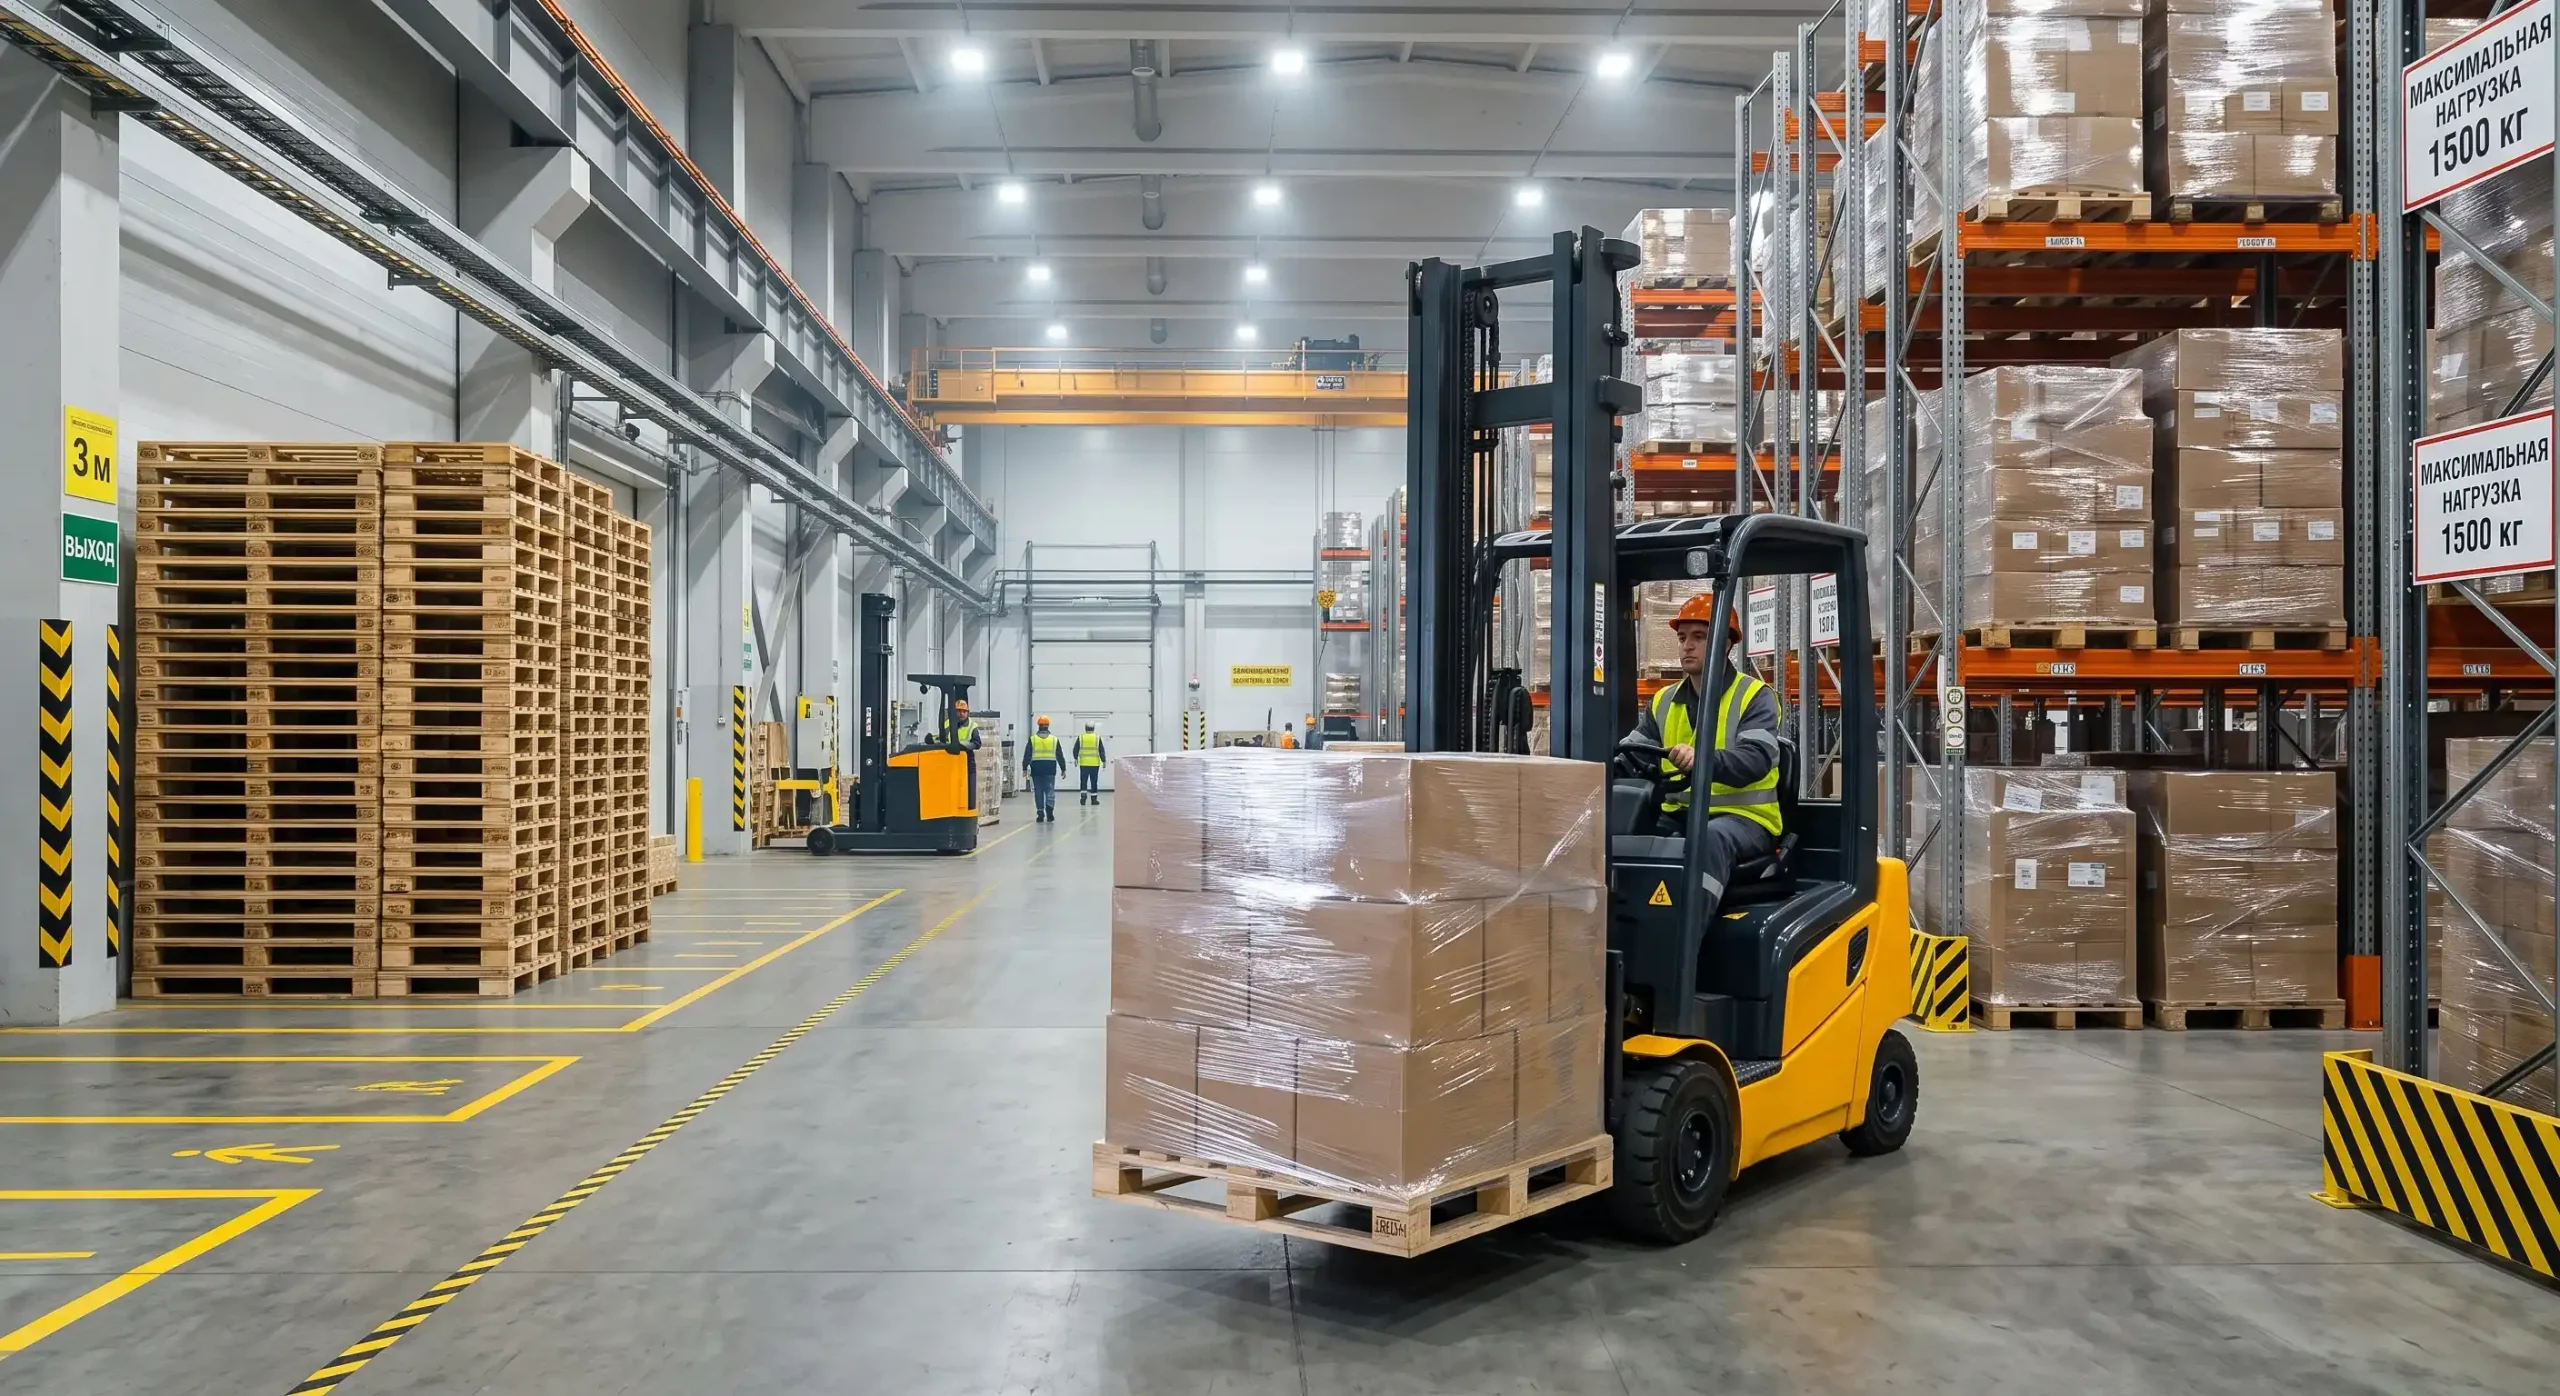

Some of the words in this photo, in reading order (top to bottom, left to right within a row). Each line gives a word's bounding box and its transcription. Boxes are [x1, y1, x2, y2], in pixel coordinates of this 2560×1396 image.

[2410, 13, 2552, 109] МАКСИМАЛЬНАЯ
[2436, 65, 2522, 128] НАГРУЗКА
[2428, 117, 2490, 177] 1500
[73, 437, 88, 477] 3
[2421, 437, 2549, 486] МАКСИМАЛЬНАЯ
[2443, 477, 2522, 514] НАГРУЗКА
[65, 534, 115, 568] ВЫХОД
[2442, 517, 2491, 555] 1500
